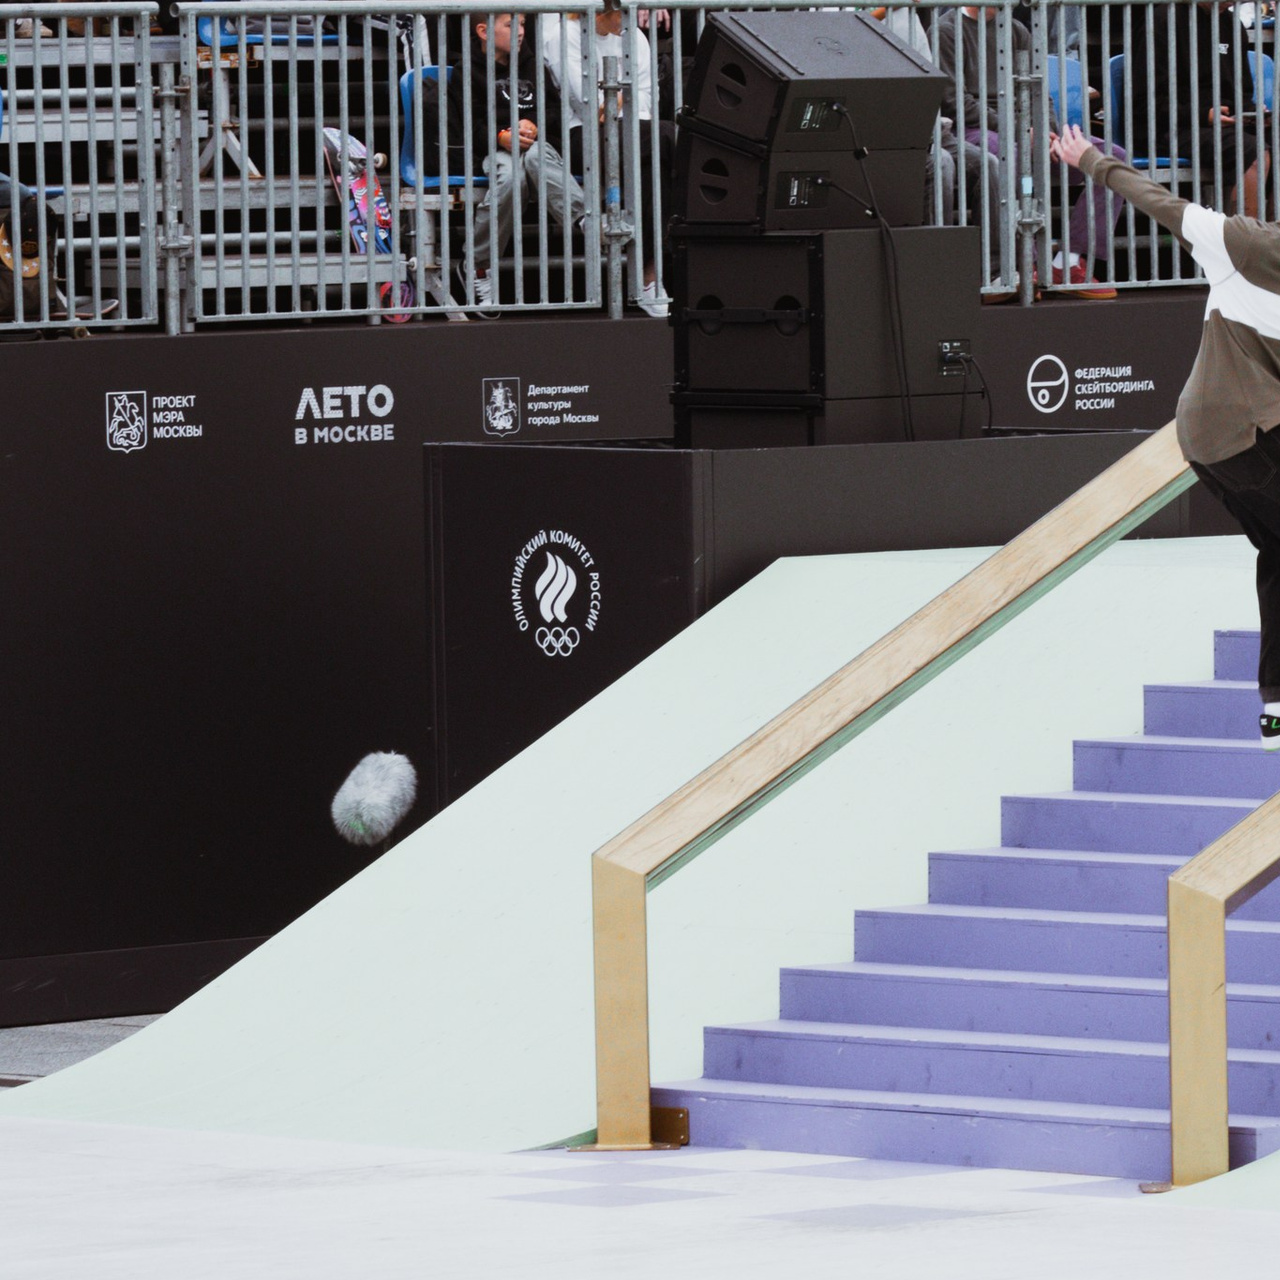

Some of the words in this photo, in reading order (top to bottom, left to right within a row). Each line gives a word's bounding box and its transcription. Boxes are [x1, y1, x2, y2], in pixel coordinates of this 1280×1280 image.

[1074, 365, 1132, 380] ФЕДЕРАЦИЯ
[527, 384, 590, 396] Департамент
[1074, 380, 1155, 395] СКЕЙТБОРДИНГА
[152, 395, 196, 409] ПРОЕКТ
[295, 384, 394, 420] ЛЕТО
[527, 400, 572, 412] культуры
[1075, 398, 1115, 410] РОССИИ
[152, 411, 185, 423] МЭРА
[528, 416, 561, 427] города
[562, 413, 600, 423] Москвы
[153, 425, 202, 438] МОСКВЫ
[294, 427, 308, 445] В
[313, 423, 395, 443] МОСКВЕ
[511, 529, 548, 631] ОЛИМПИЙСКИЙ
[549, 529, 595, 568] КОМИТЕТ
[584, 571, 602, 632] РОССИИ
